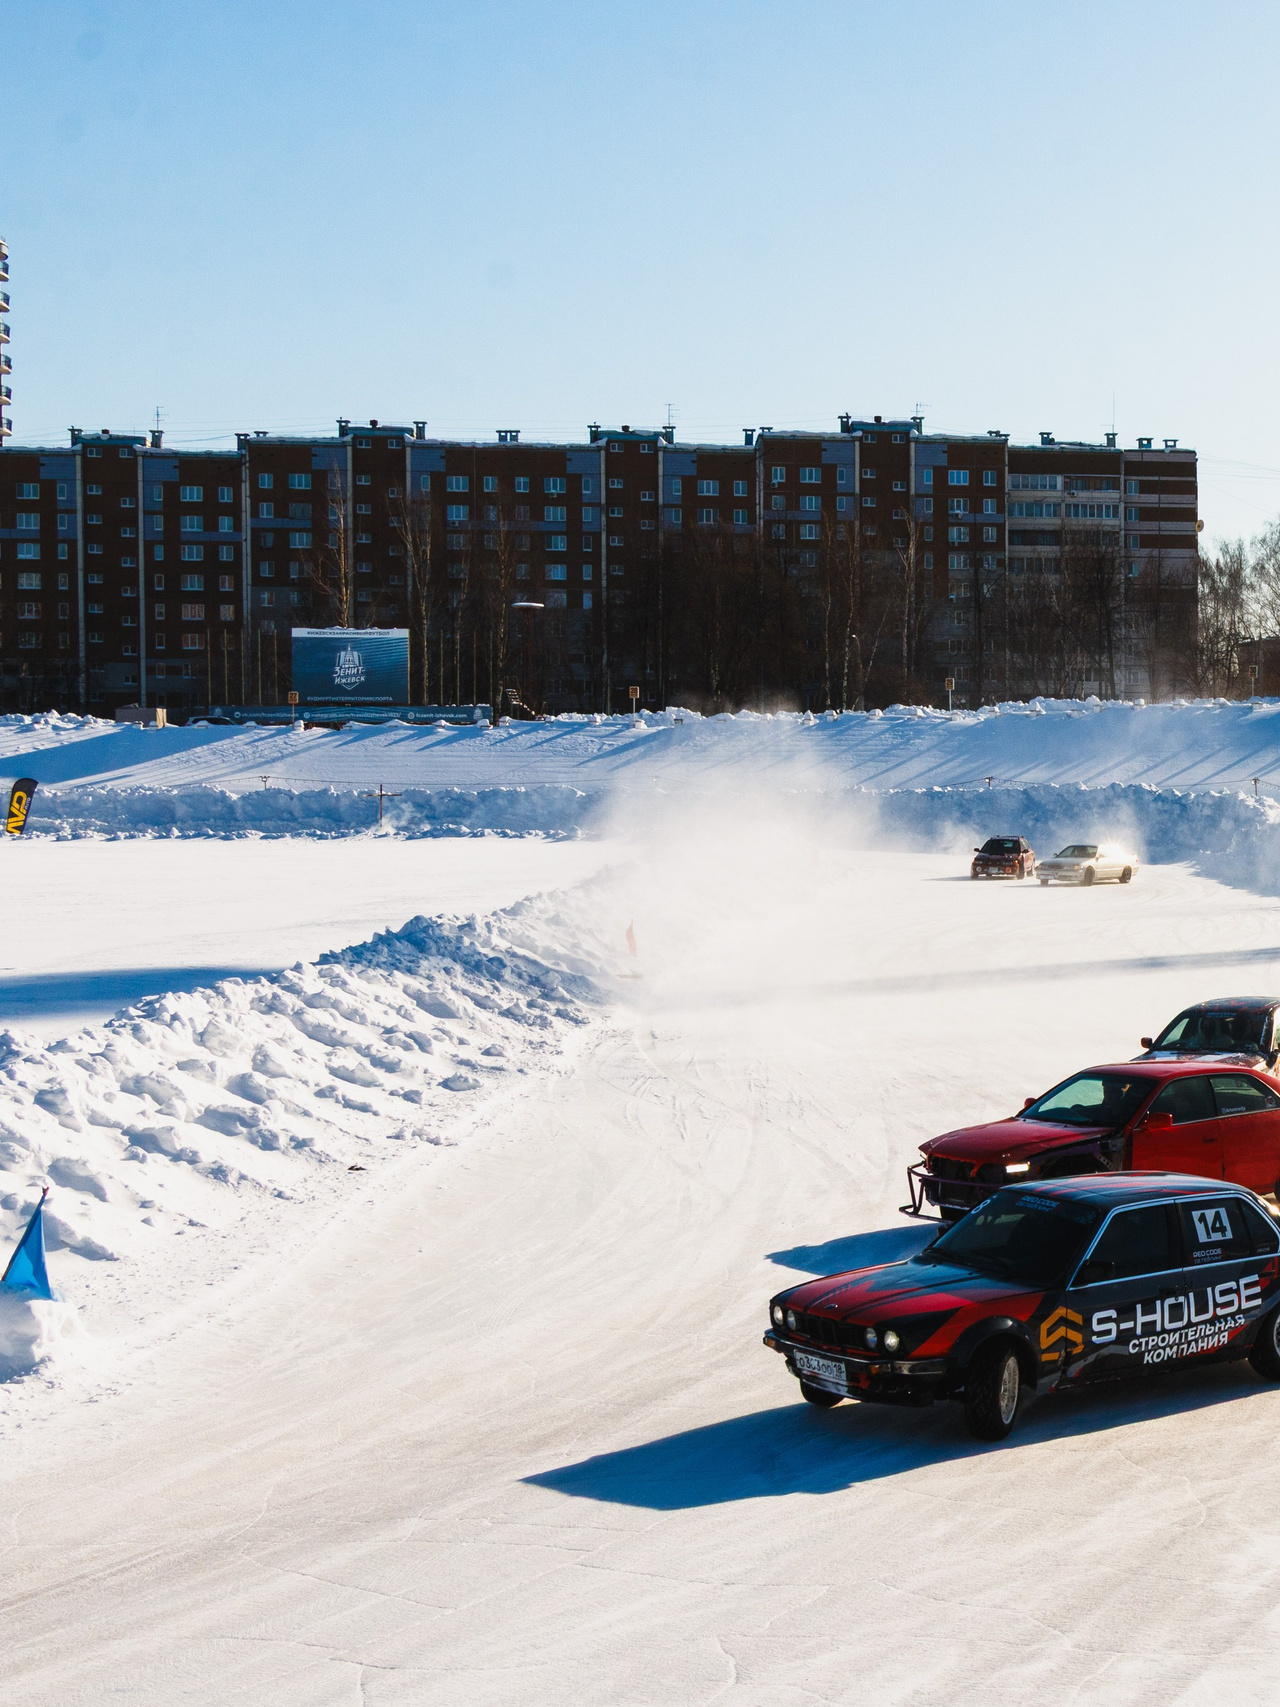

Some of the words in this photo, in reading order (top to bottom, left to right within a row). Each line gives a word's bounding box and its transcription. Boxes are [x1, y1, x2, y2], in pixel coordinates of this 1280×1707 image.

[334, 676, 365, 684] ИЖЕВСК
[1198, 1210, 1227, 1239] 14
[1092, 1274, 1262, 1344] S-HOUSE
[1128, 1314, 1245, 1354] СТРОИТЕЛЬНАЯ
[1143, 1331, 1228, 1364] КОМПАНИЯ
